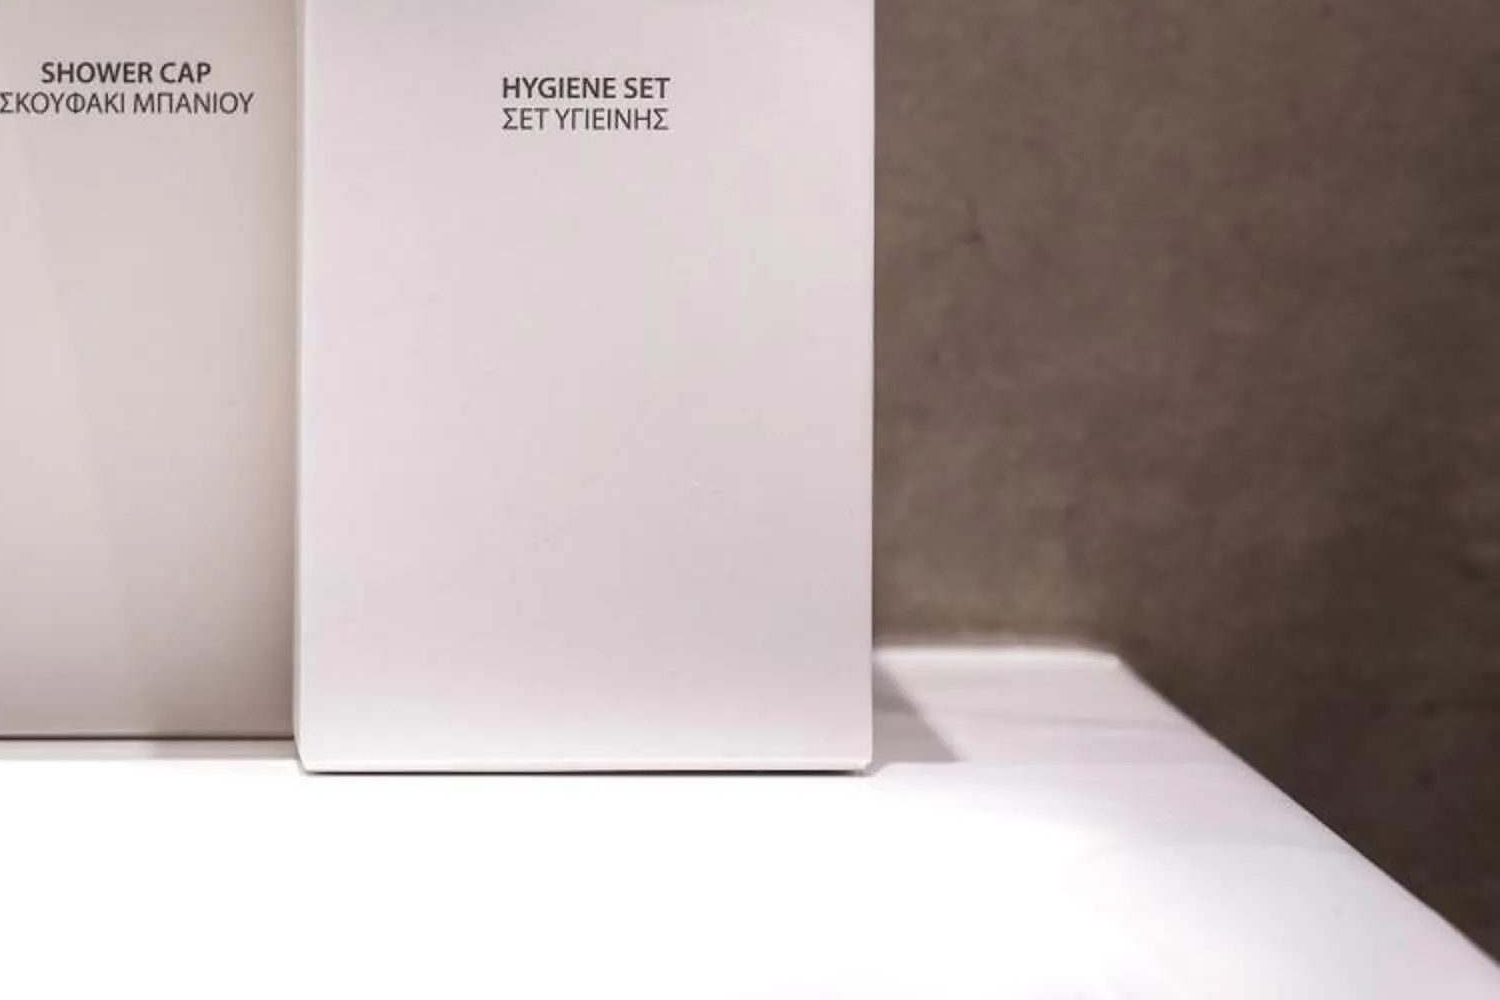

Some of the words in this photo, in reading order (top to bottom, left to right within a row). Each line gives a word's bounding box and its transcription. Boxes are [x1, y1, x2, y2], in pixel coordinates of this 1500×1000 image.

[41, 61, 153, 84] SHOWER
[160, 61, 212, 84] CAP
[502, 77, 616, 99] HYGIENE
[624, 77, 671, 99] SET
[133, 91, 254, 114] ΜΠΑΝΙΟΥ
[502, 107, 549, 130] ΣΕΤ
[555, 107, 669, 130] ΥΓΙΕΙΝΗΣ
